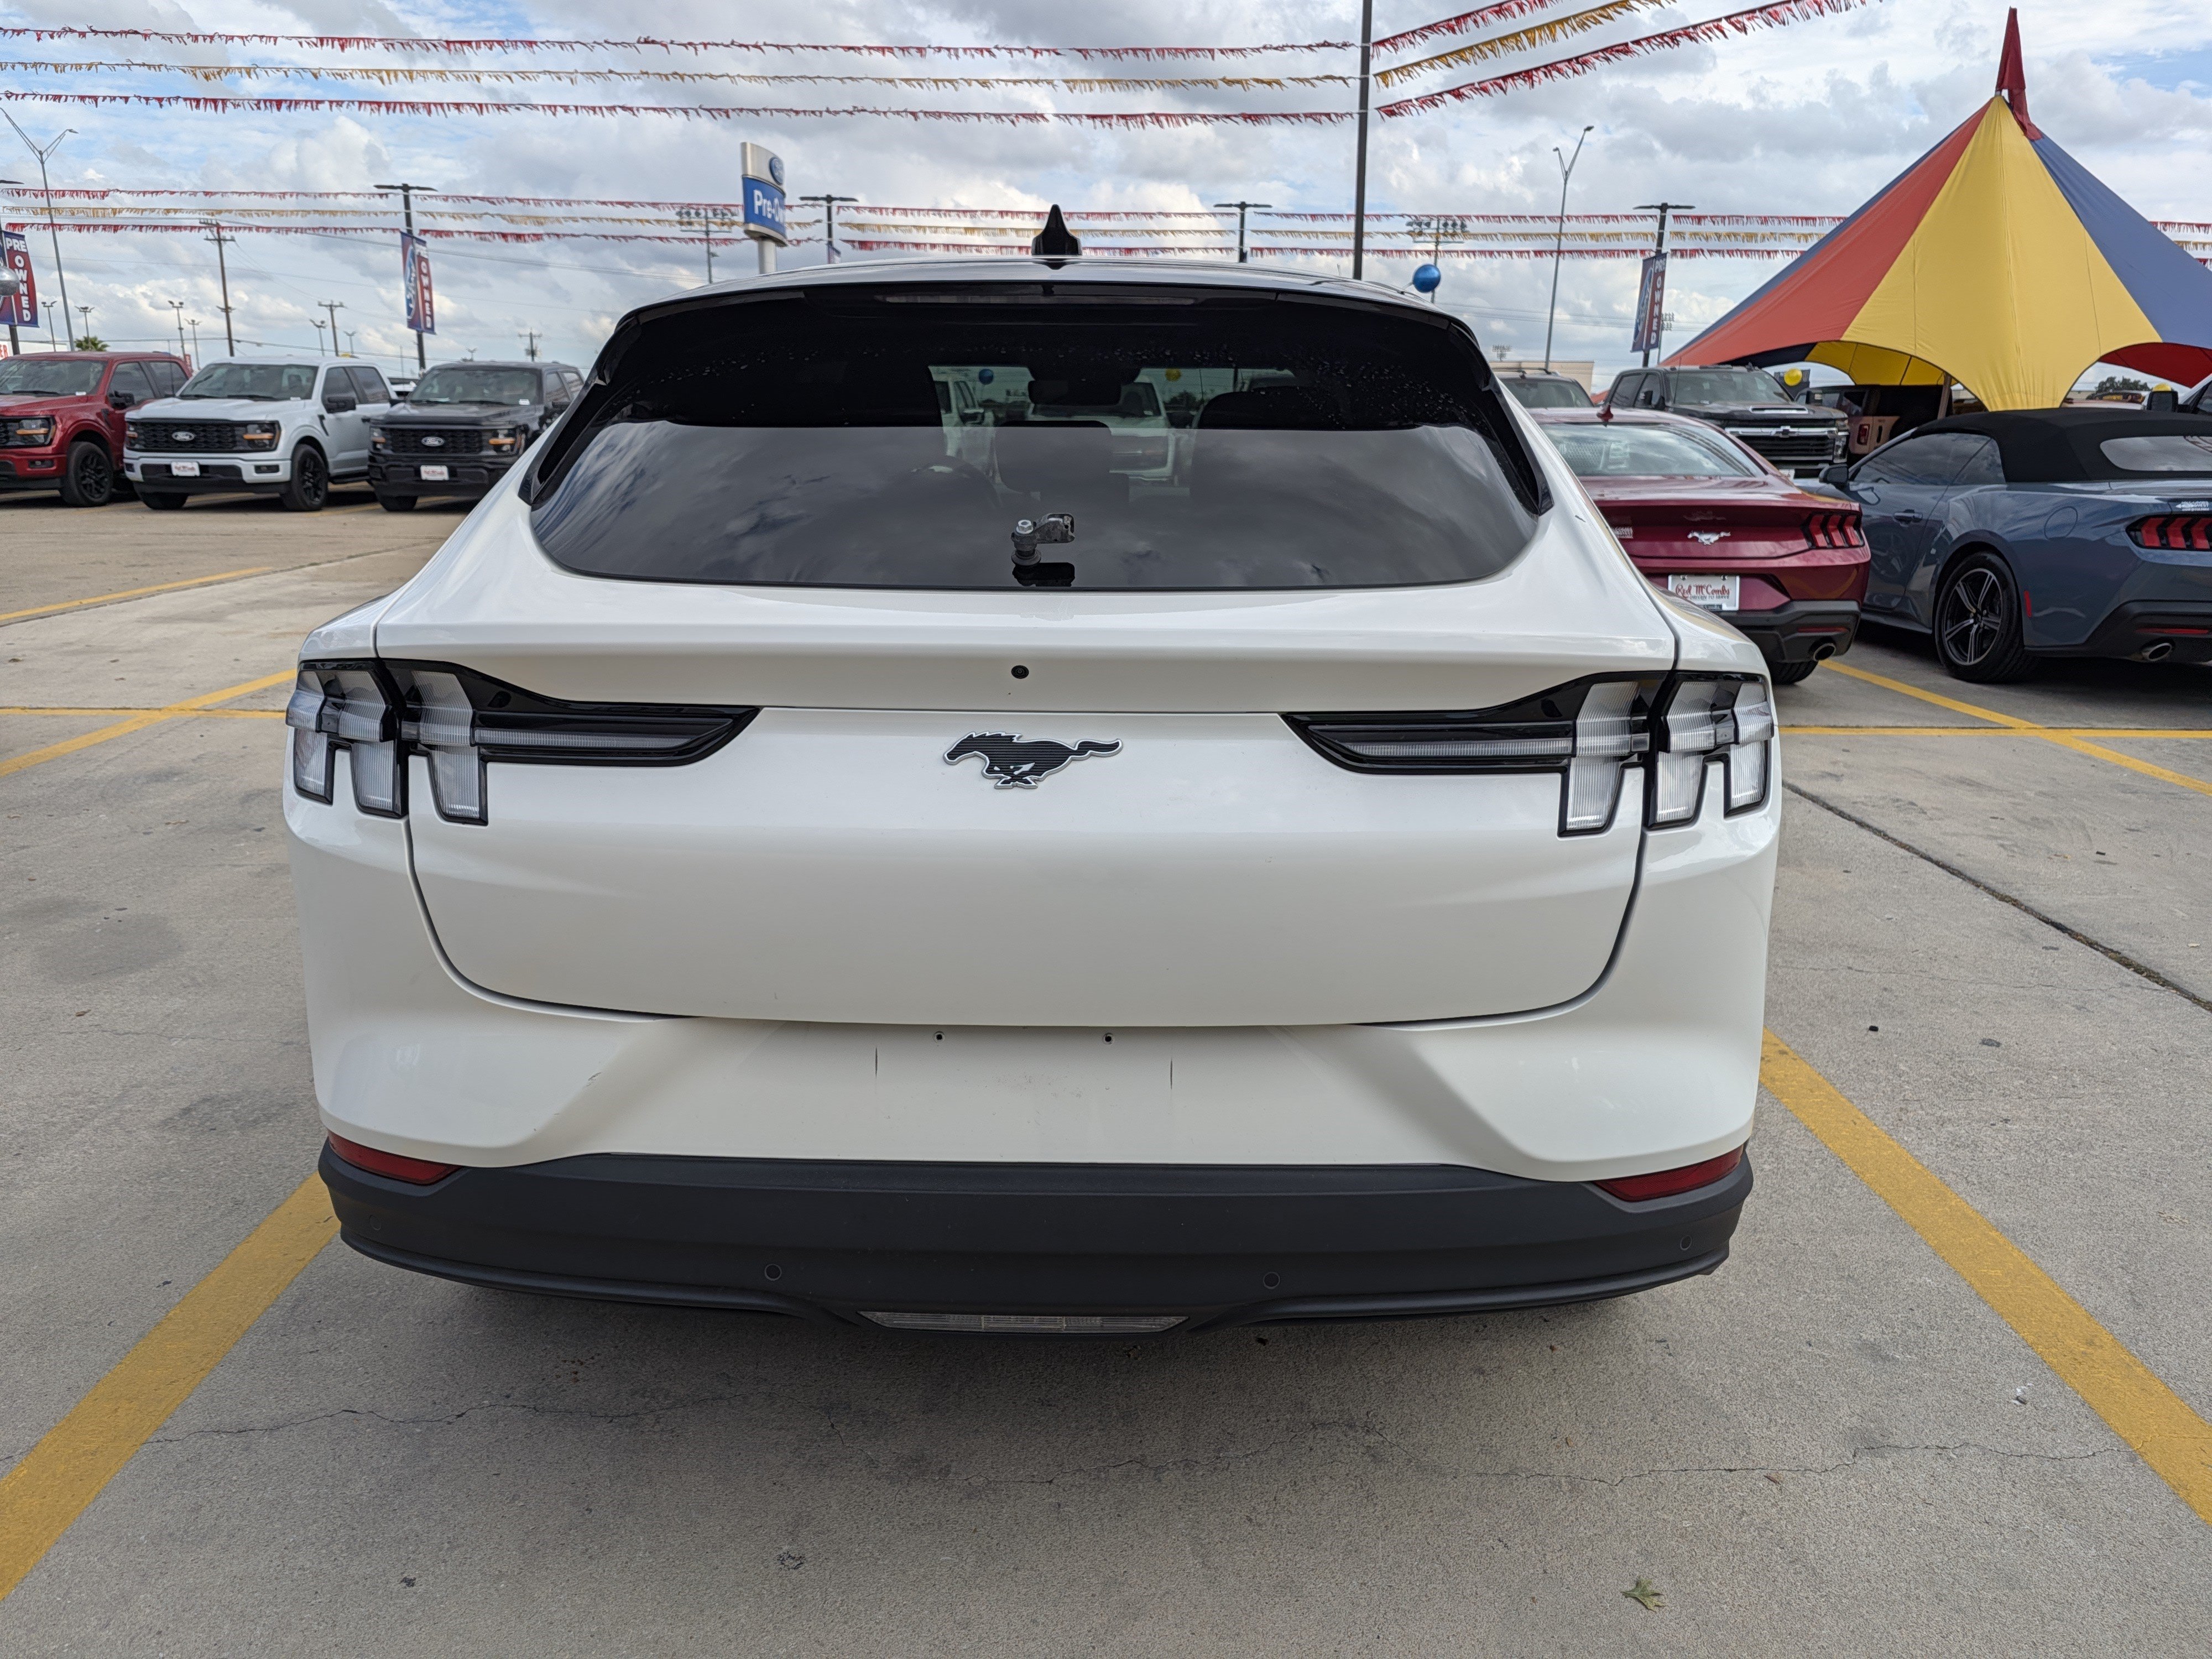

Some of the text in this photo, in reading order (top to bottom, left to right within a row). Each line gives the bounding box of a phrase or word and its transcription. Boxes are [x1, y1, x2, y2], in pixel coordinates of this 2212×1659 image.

[6, 237, 27, 252] PRE
[14, 255, 31, 322] OWNED
[420, 260, 432, 328] OWNED
[1650, 275, 1662, 345] OWNED
[1675, 583, 1692, 599] Red
